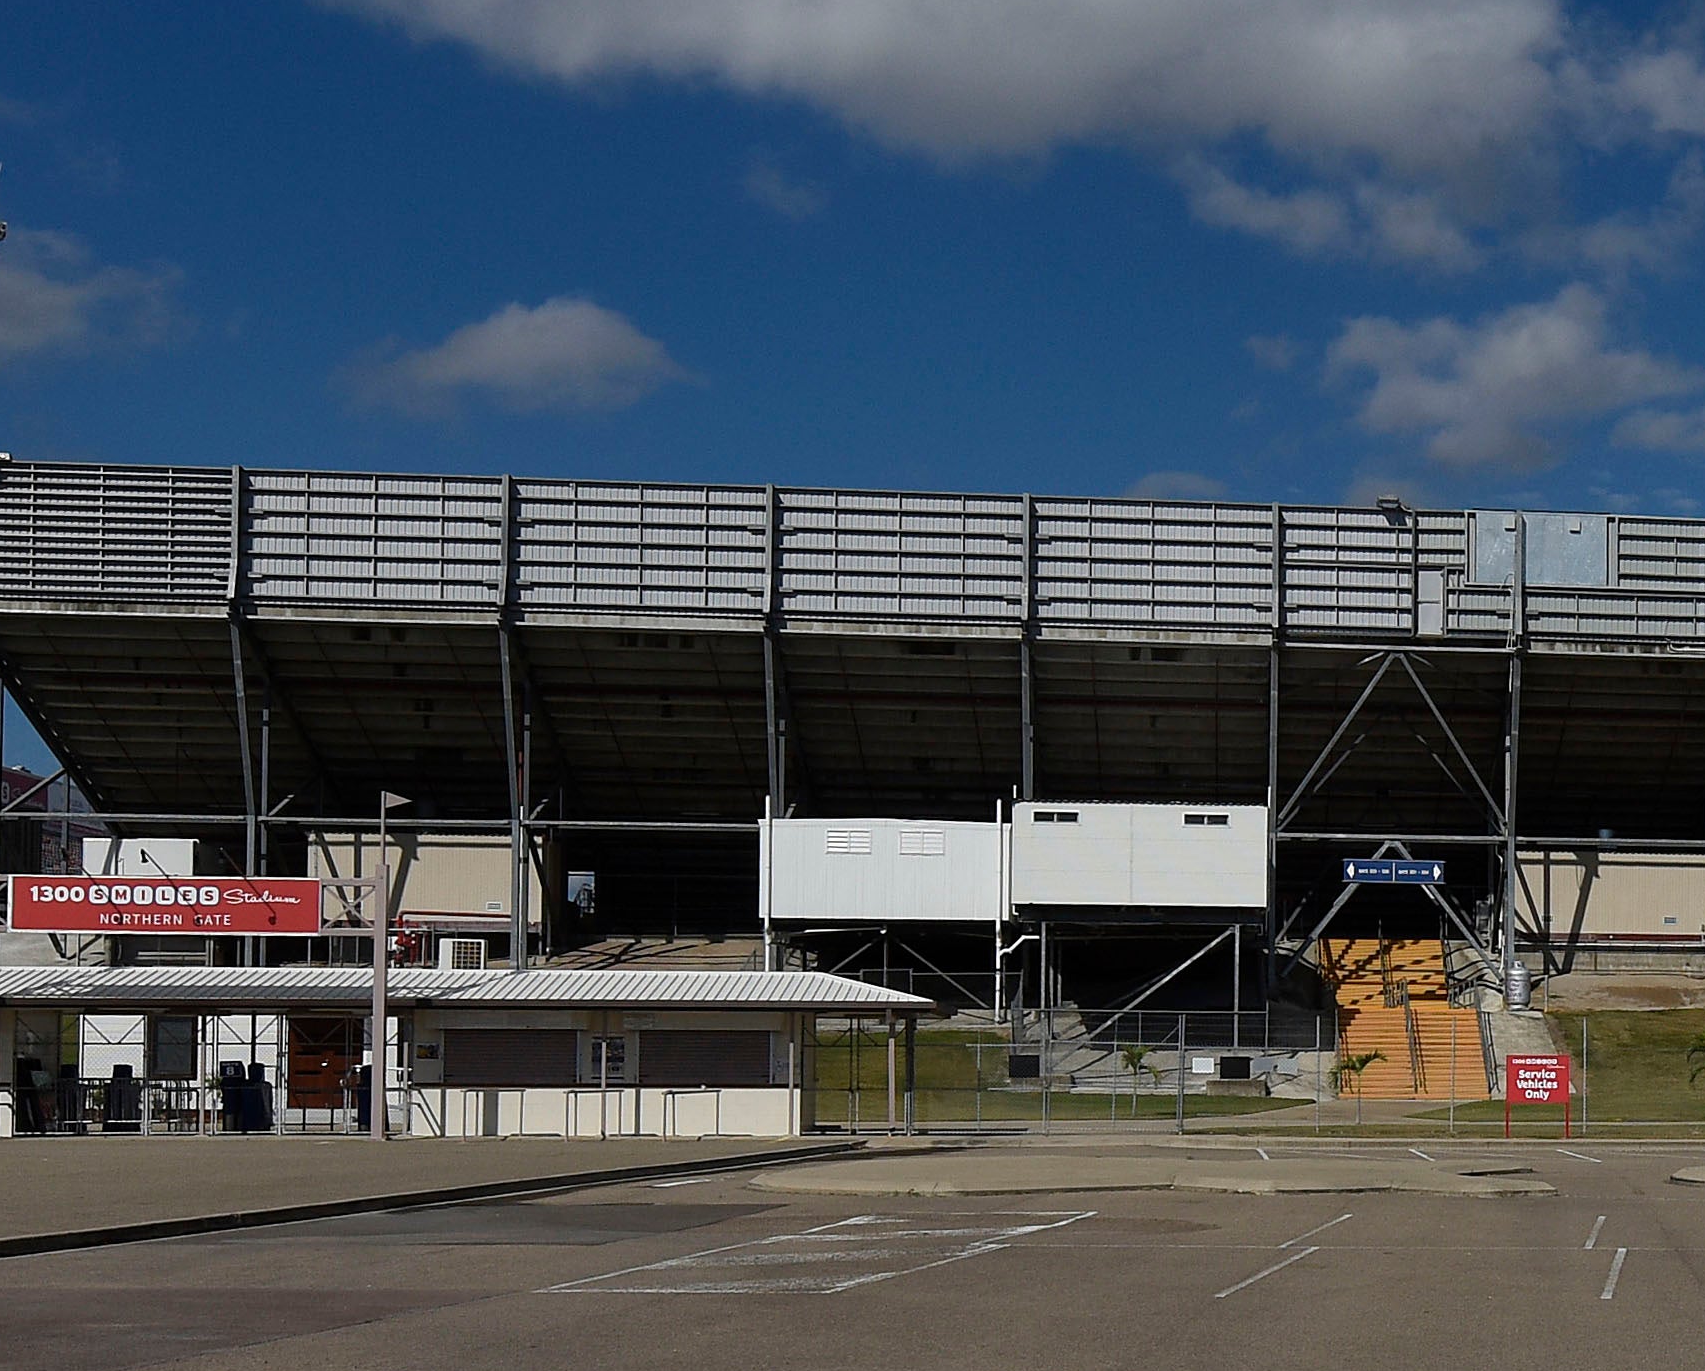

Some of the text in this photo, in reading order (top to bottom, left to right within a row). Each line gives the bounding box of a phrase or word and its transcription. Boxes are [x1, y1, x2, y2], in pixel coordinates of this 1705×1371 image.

[30, 884, 301, 906] 1300 SMILES Stadium
[99, 913, 232, 926] NORTHERN GATE
[226, 1066, 235, 1076] 8
[1518, 1068, 1557, 1079] Service
[1516, 1078, 1558, 1089] Vehicles
[1524, 1089, 1550, 1101] Only
